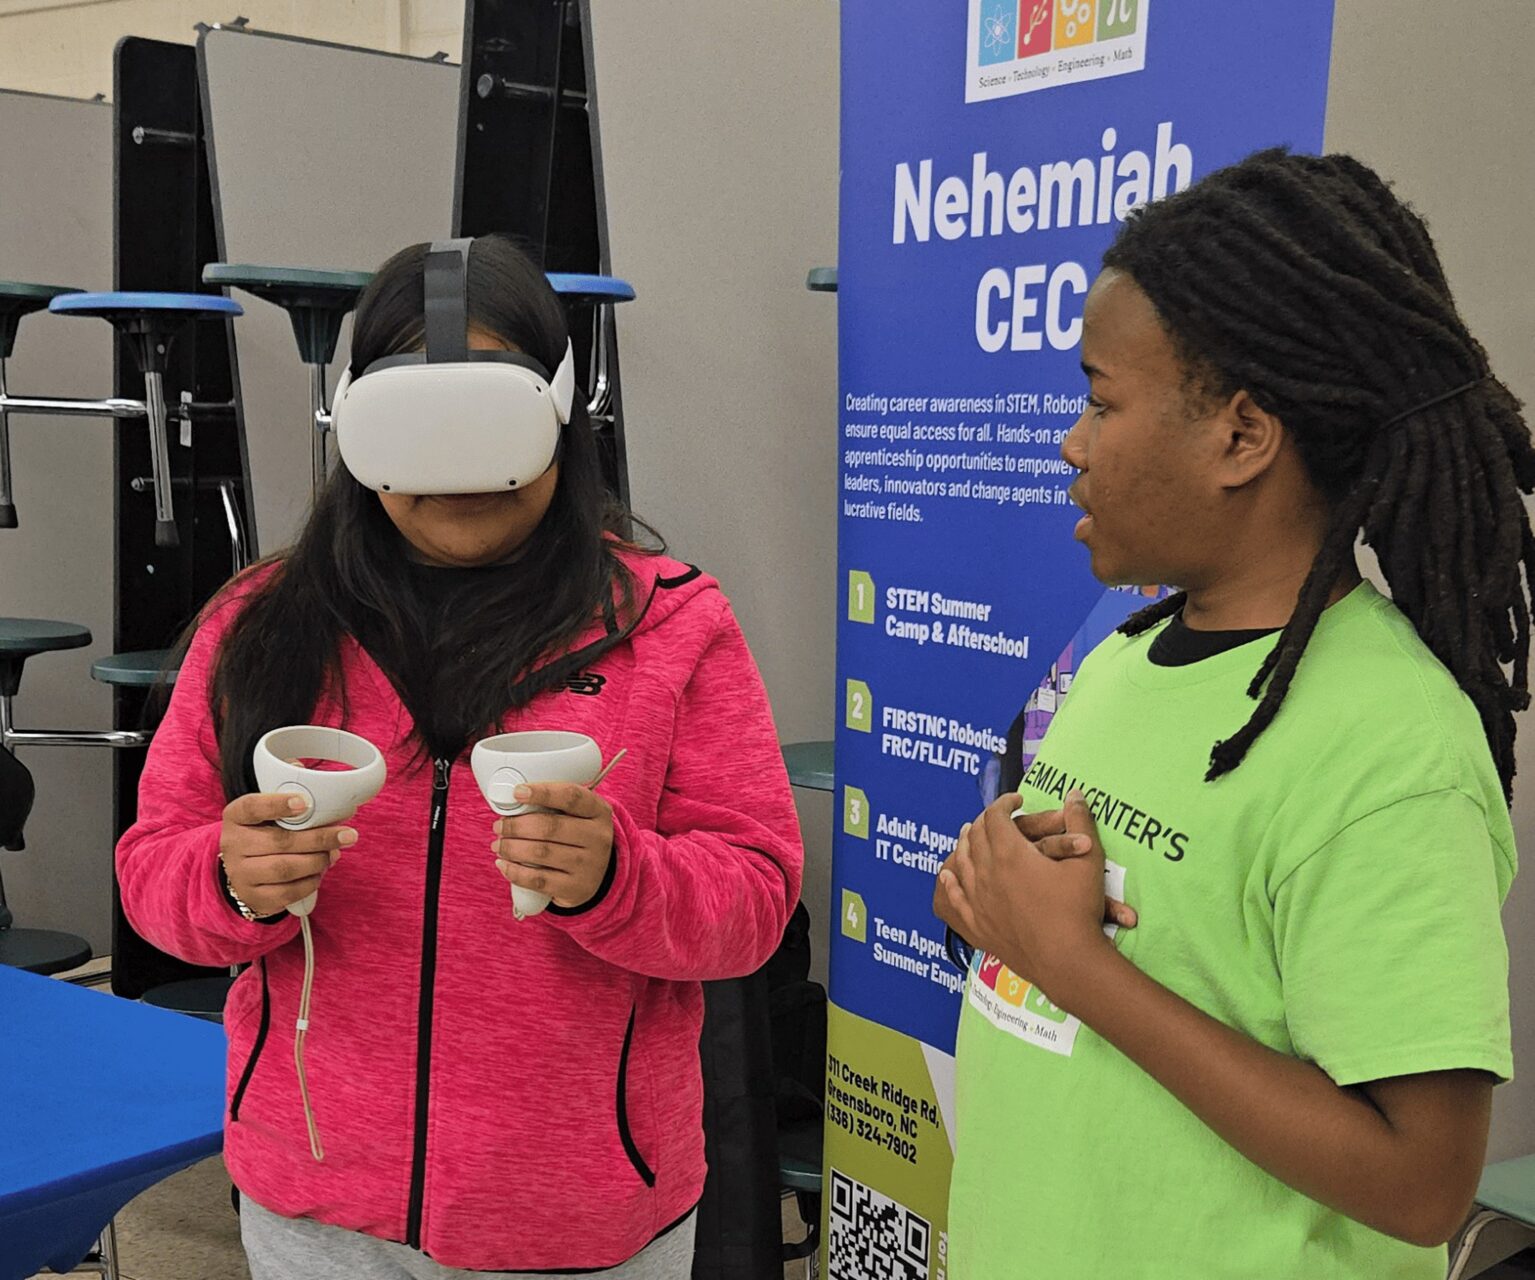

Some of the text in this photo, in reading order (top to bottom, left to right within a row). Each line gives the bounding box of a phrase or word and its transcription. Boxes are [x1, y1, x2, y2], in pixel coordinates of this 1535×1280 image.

[979, 48, 1133, 88] Science Technology Engineering Math
[892, 121, 1193, 244] Nehemiah
[975, 261, 1088, 353] CEC
[846, 393, 888, 415] Creating
[890, 397, 929, 412] career
[930, 397, 993, 413] awareness
[995, 394, 1005, 413] in
[1006, 393, 1041, 416] STEM,
[845, 424, 878, 439] ensure
[880, 421, 911, 443] equal
[913, 425, 956, 441] access
[957, 423, 975, 441] for
[976, 423, 993, 442] all.
[997, 424, 1051, 444] Hands-on
[845, 448, 1075, 477] apprenticeship opportunities to empower
[844, 475, 1067, 507] leaders, innovators and change agents in
[844, 499, 923, 522] lucrative fields.
[856, 583, 865, 610] 1
[886, 587, 992, 622] STEM Summer
[886, 615, 1029, 659] Camp & Afterschool
[852, 692, 864, 719] 2
[882, 706, 1008, 755] FIRSTNC Robotics
[881, 733, 980, 776] FRC/FLL/FTC
[850, 799, 861, 825] 3
[876, 813, 918, 842] Adult
[875, 839, 891, 860] IT
[846, 903, 858, 929] 4
[873, 917, 907, 945] Teen
[873, 942, 930, 978] Summer
[1035, 1024, 1058, 1042] Math
[828, 1053, 939, 1129] 311 Creek Ridge Rd,
[828, 1078, 918, 1139] Greensboro, NC
[827, 1099, 917, 1164] (336) 324-7902
[938, 1230, 948, 1266] for
